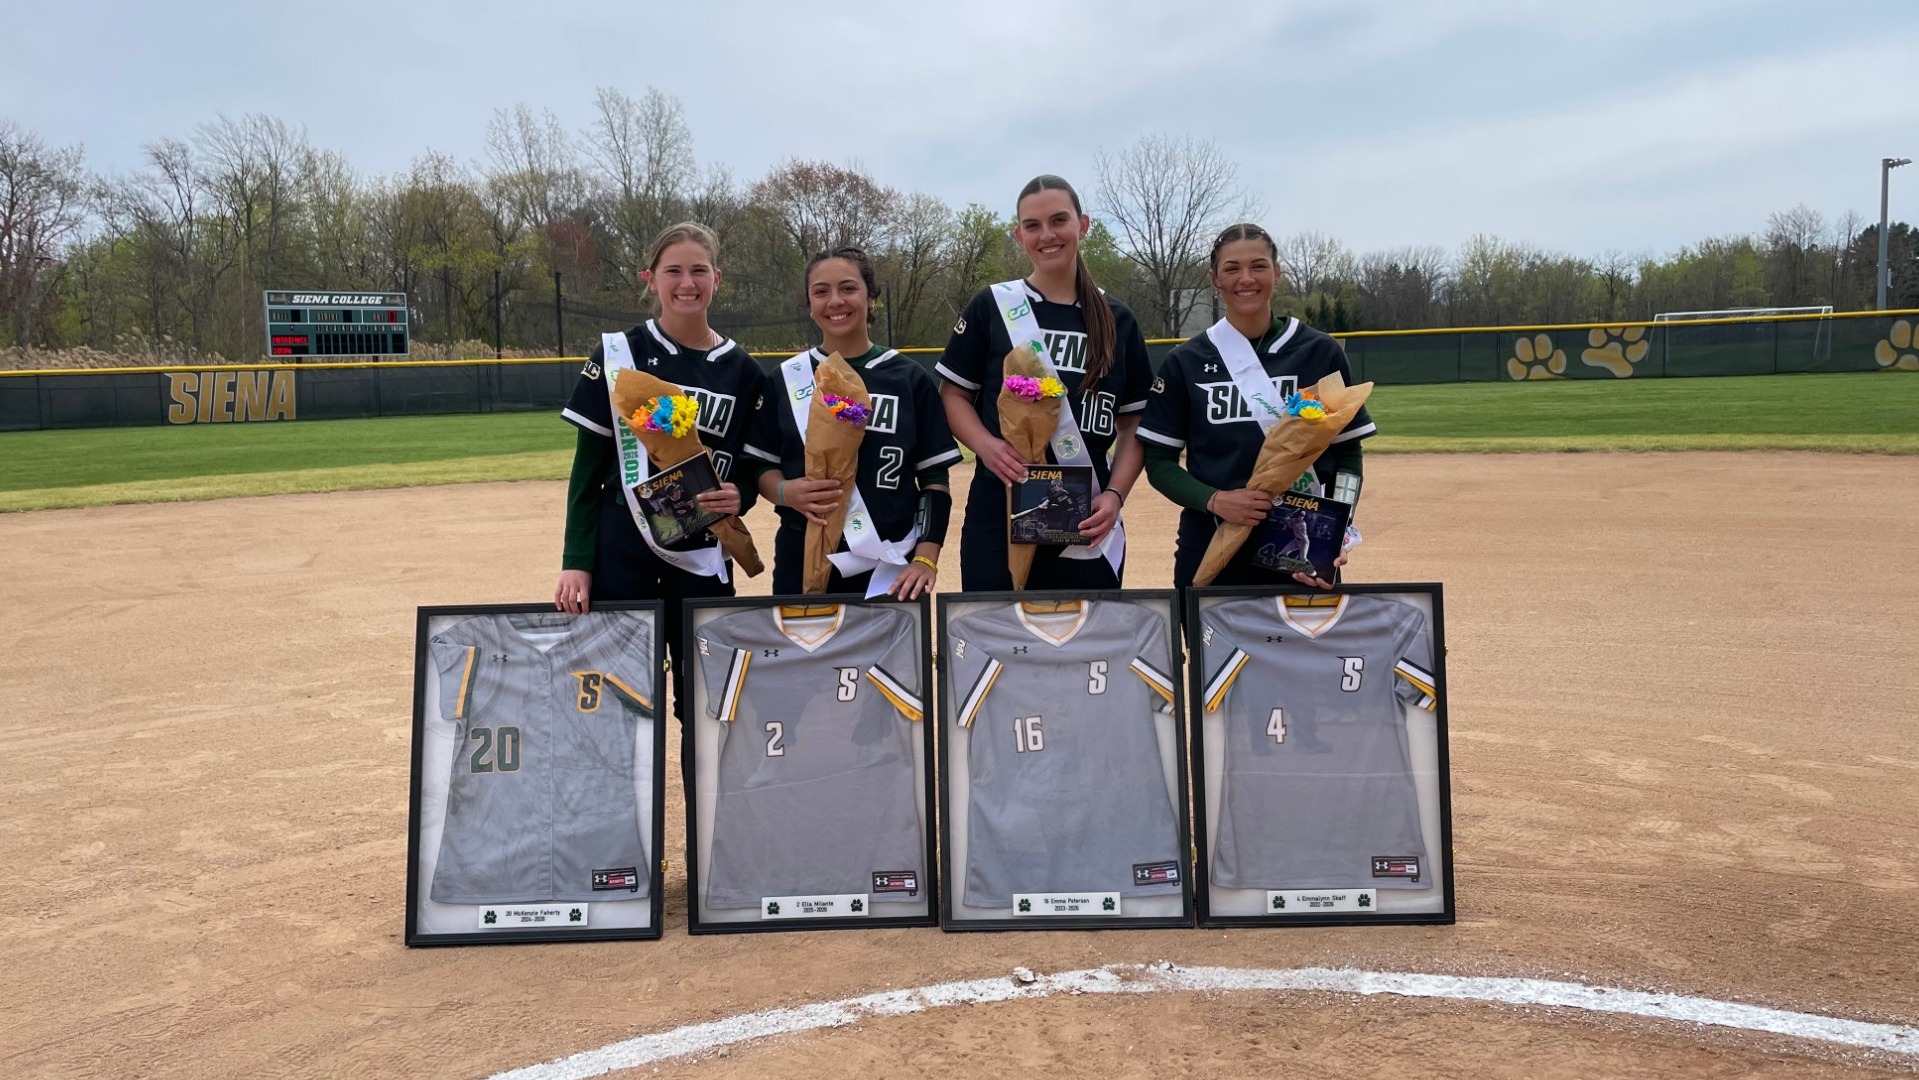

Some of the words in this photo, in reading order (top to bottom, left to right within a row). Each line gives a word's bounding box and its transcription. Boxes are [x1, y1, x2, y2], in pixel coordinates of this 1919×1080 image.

[292, 294, 330, 304] SIENA
[332, 295, 383, 305] COLLEGE
[164, 371, 296, 424] SIENA
[1080, 389, 1116, 436] 16
[652, 470, 684, 491] SIENA
[876, 446, 904, 490] 2
[1030, 470, 1063, 480] SIENA
[1284, 495, 1319, 511] SIENA
[571, 670, 603, 713] S
[834, 666, 860, 702] S
[1083, 660, 1109, 695] S
[1338, 656, 1365, 692] S
[765, 721, 785, 757] 2
[1013, 715, 1044, 753] 16
[1266, 708, 1287, 744] 4
[469, 725, 522, 775] 20
